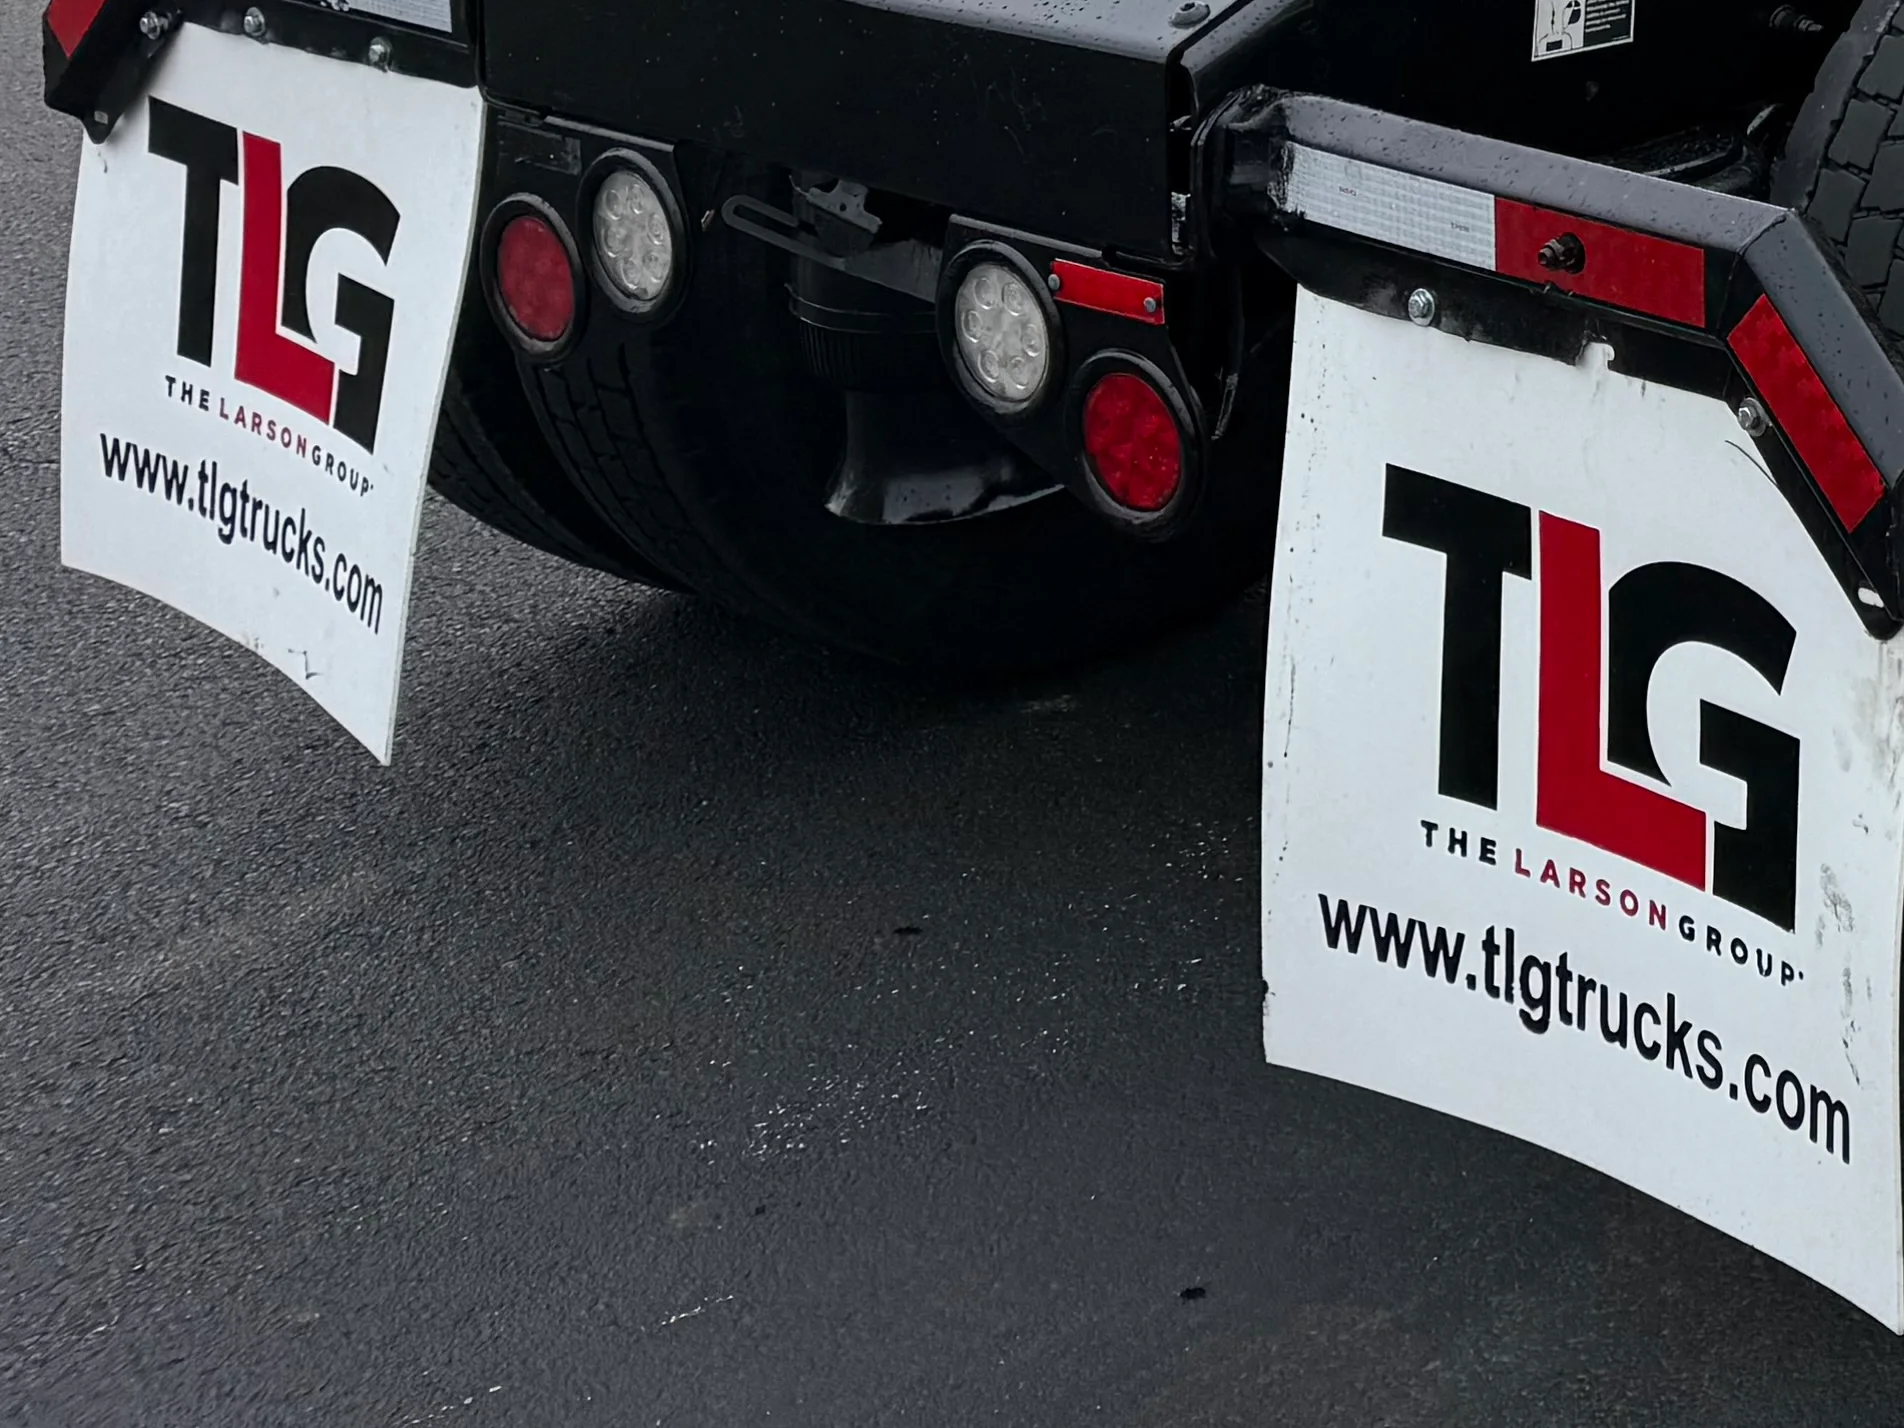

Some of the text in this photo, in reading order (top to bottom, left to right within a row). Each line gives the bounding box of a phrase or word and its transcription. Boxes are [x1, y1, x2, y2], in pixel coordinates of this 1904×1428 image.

[148, 96, 401, 455] TLG
[100, 432, 383, 635] www.tlgtrucks.com
[165, 375, 370, 497] THE LARSON GROUP
[1383, 463, 1801, 934] TLG
[1420, 819, 1797, 987] THE LARSON GROUP
[1318, 893, 1851, 1164] www.tlgtrucks.com
